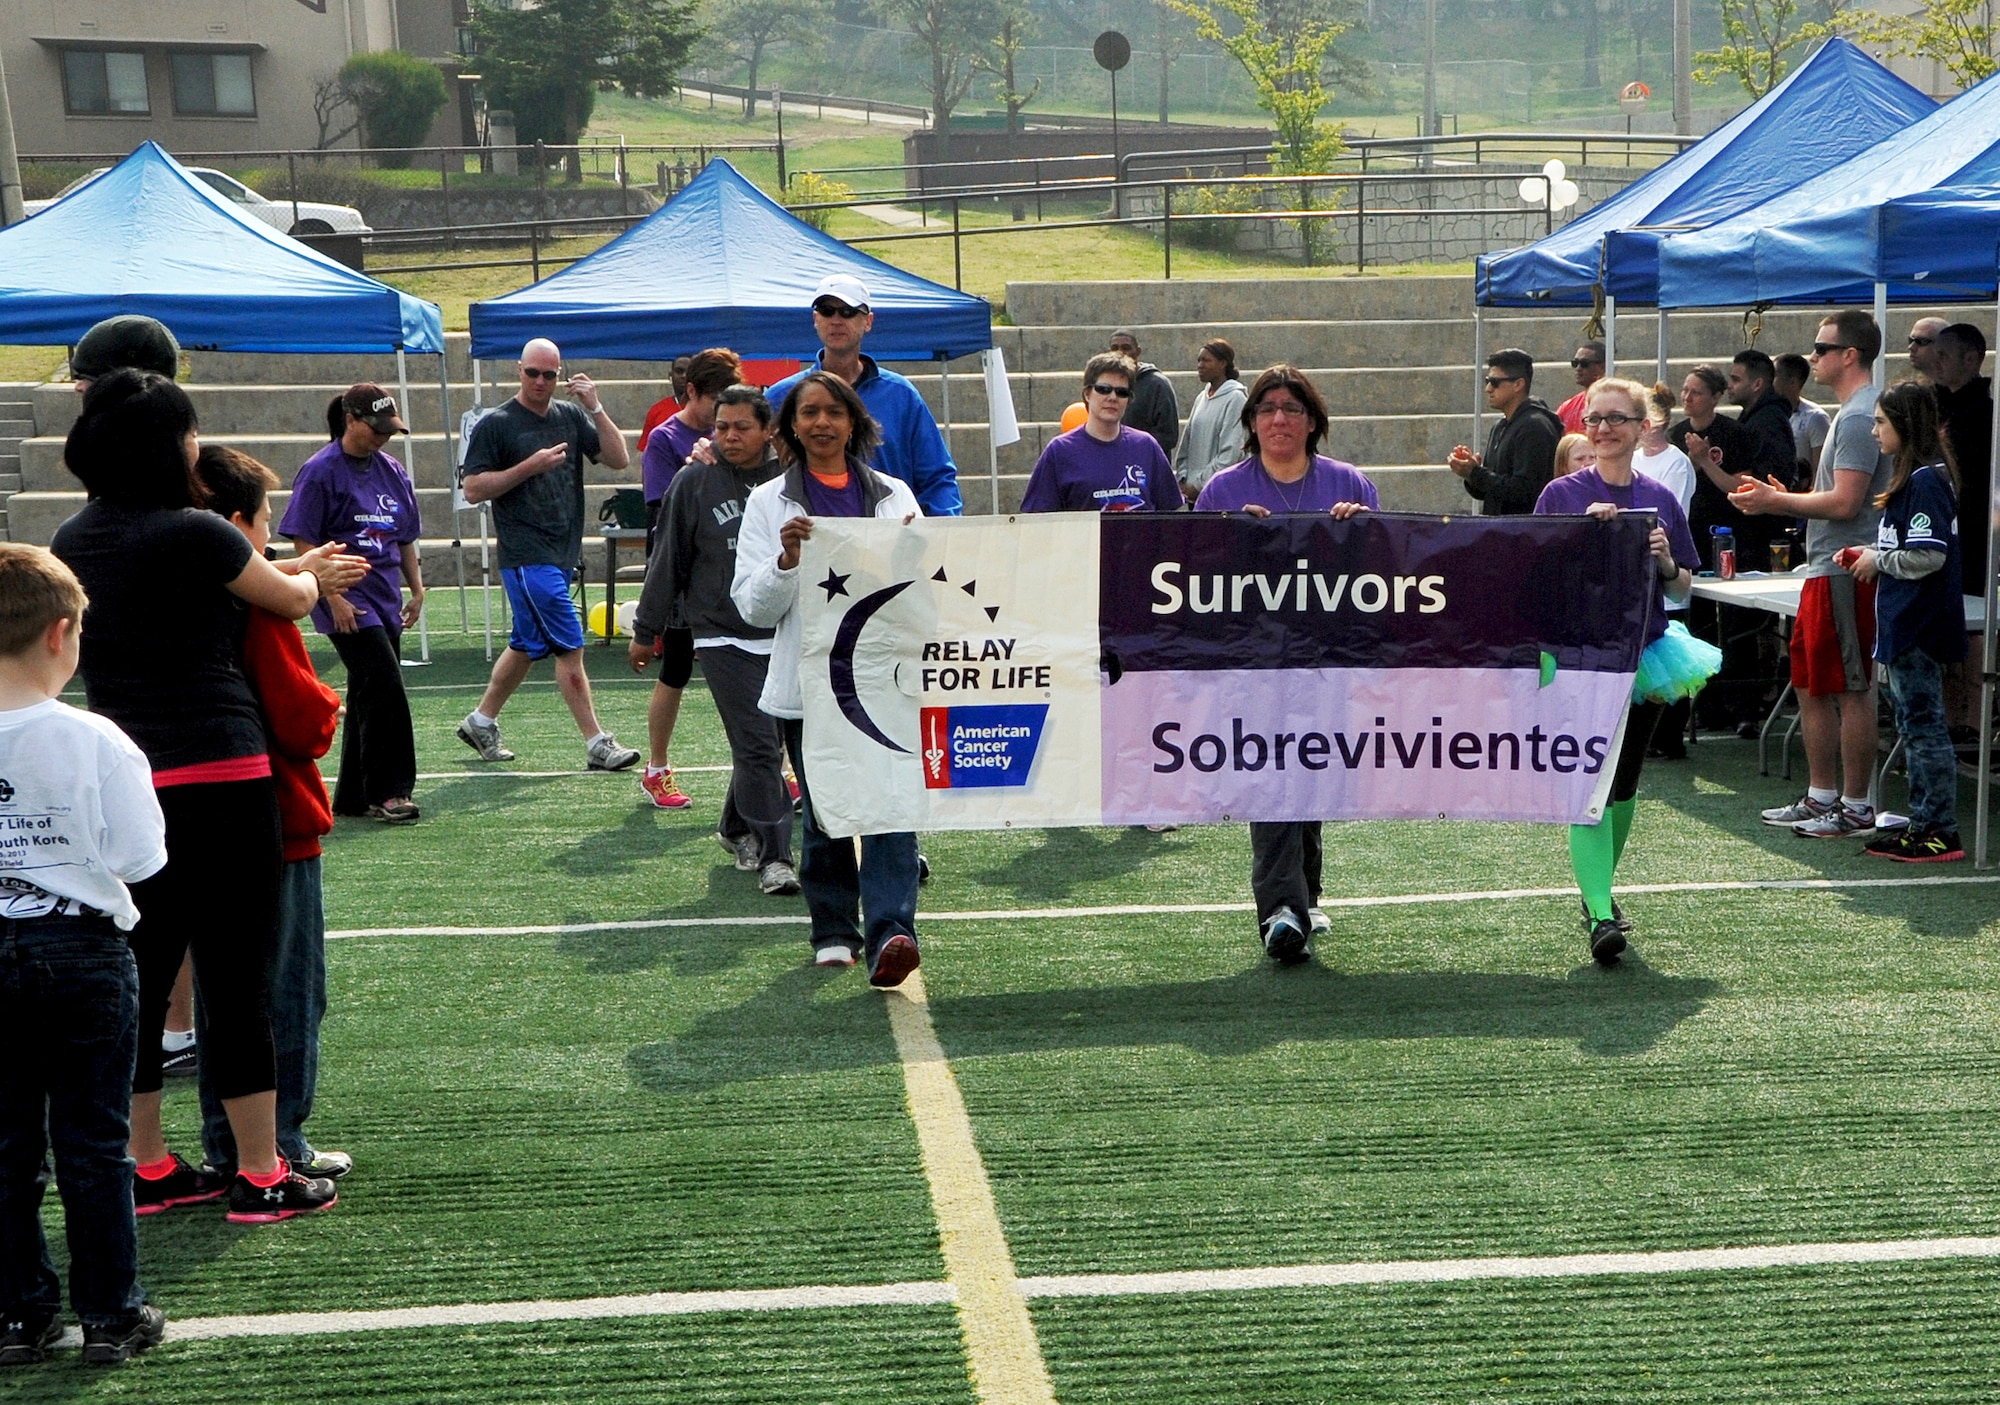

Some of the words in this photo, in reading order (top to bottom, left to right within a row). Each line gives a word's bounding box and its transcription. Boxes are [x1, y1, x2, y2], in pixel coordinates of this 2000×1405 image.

[1150, 558, 1447, 615] Survivors
[922, 638, 1017, 662] RELAY
[922, 667, 981, 692] FOR
[991, 665, 1052, 690] LIFE
[953, 724, 1031, 740] American
[953, 740, 1009, 755] Cancer
[1151, 716, 1609, 775] Sobrevivientes
[953, 754, 1013, 770] Society
[7, 817, 34, 830] Life
[37, 816, 52, 829] of
[8, 850, 27, 858] 2013
